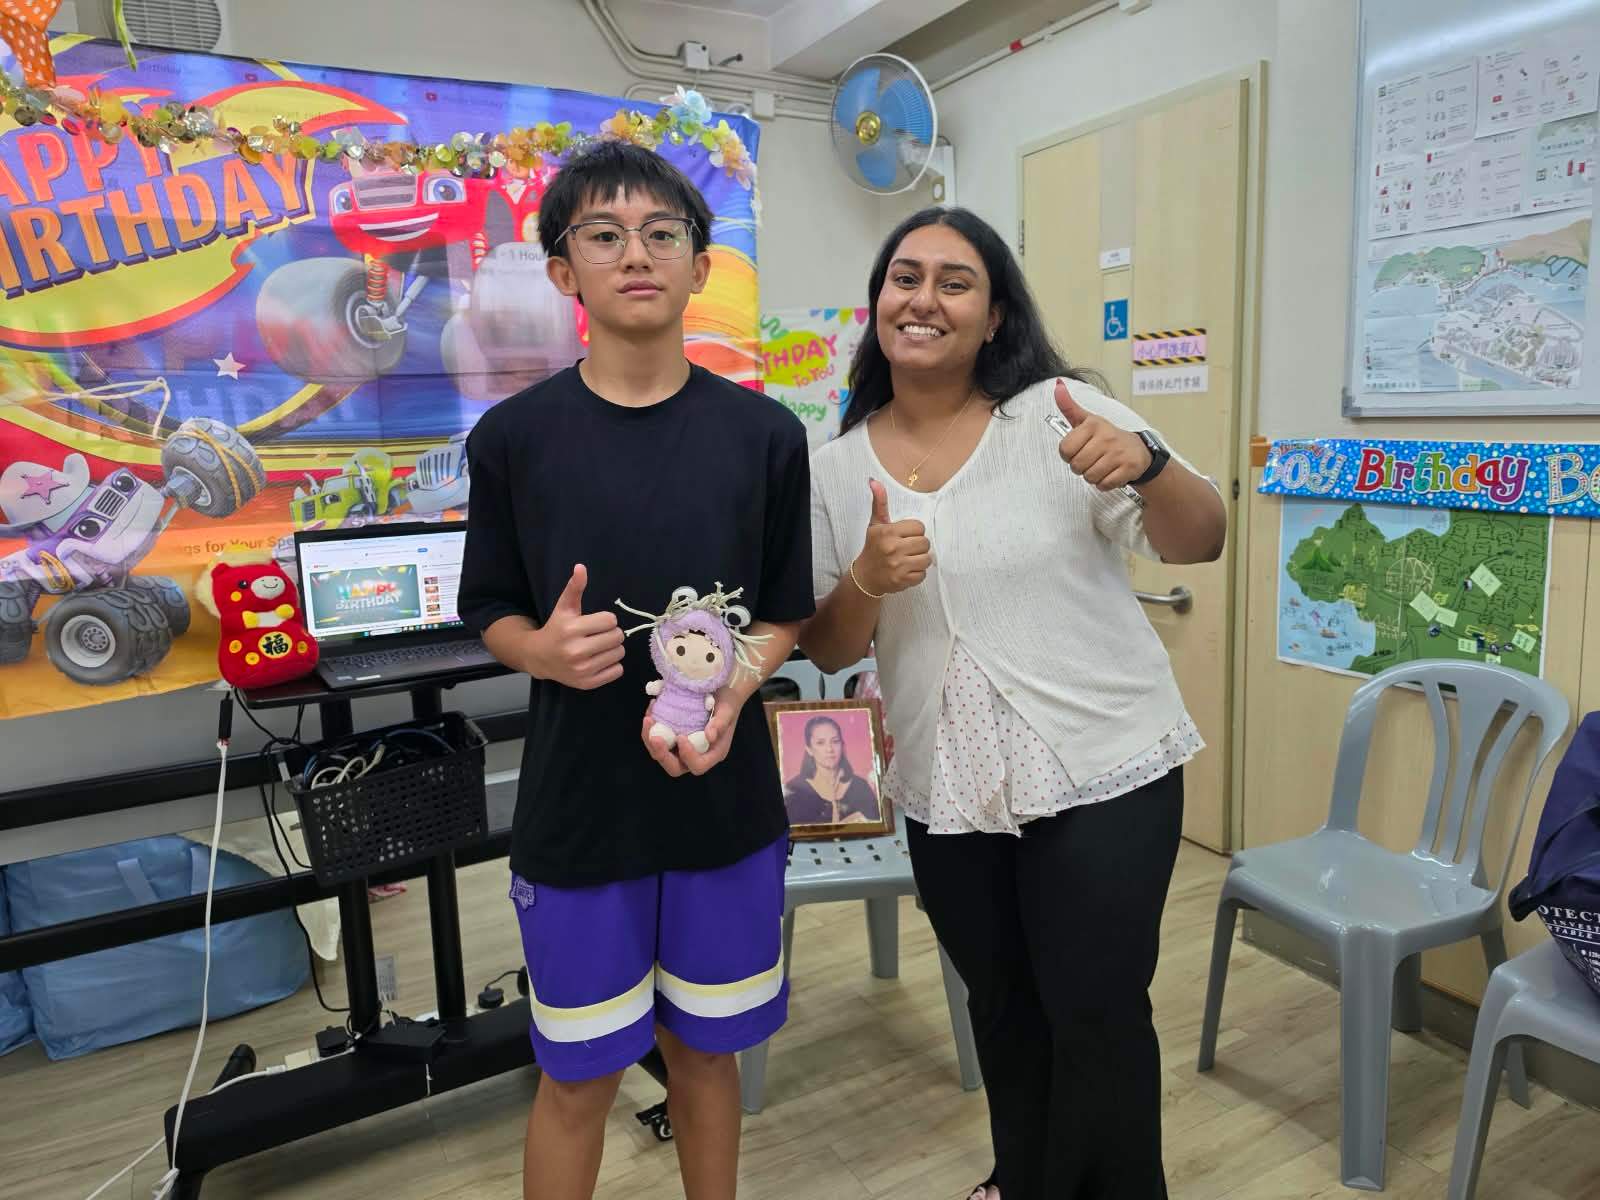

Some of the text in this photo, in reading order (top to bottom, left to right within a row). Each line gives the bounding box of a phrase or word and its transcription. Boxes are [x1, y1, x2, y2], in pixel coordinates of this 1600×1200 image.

[1353, 447, 1531, 504] Birthday
[205, 541, 225, 553] for
[336, 589, 403, 610] BIRTHDAY
[262, 633, 289, 655] 福
